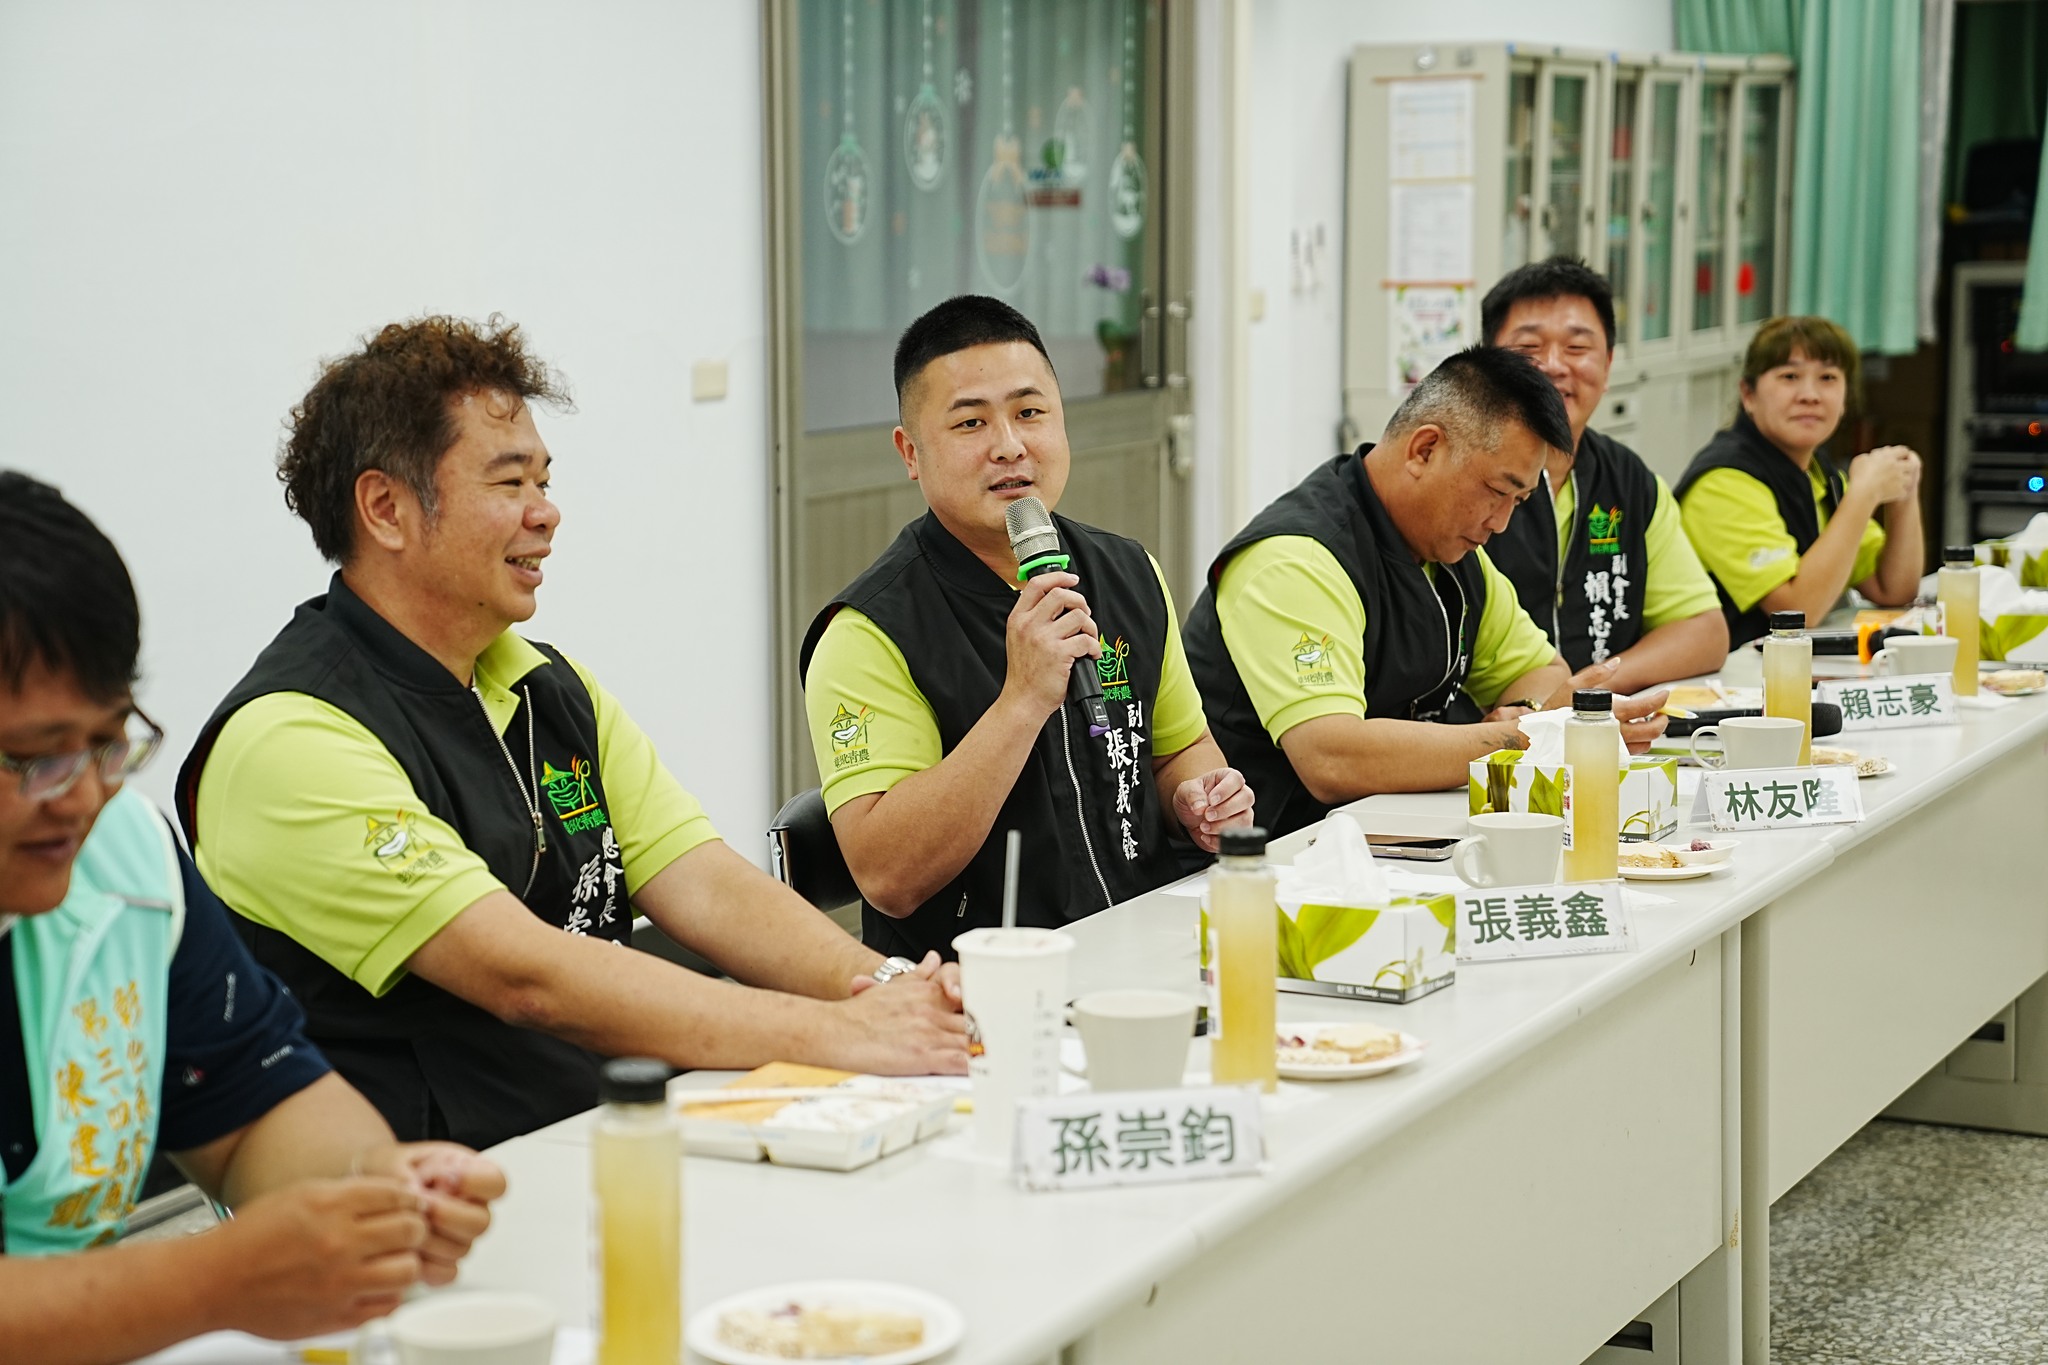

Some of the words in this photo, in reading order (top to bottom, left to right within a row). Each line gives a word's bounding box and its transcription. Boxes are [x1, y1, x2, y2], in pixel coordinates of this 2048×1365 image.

[1612, 553, 1631, 621] 副會長
[1839, 683, 1941, 721] 賴志豪
[1127, 701, 1146, 788] 副會長
[1724, 777, 1842, 822] 林友隆
[1465, 891, 1609, 944] 張義鑫
[1049, 1107, 1235, 1175] 孫崇鈞
